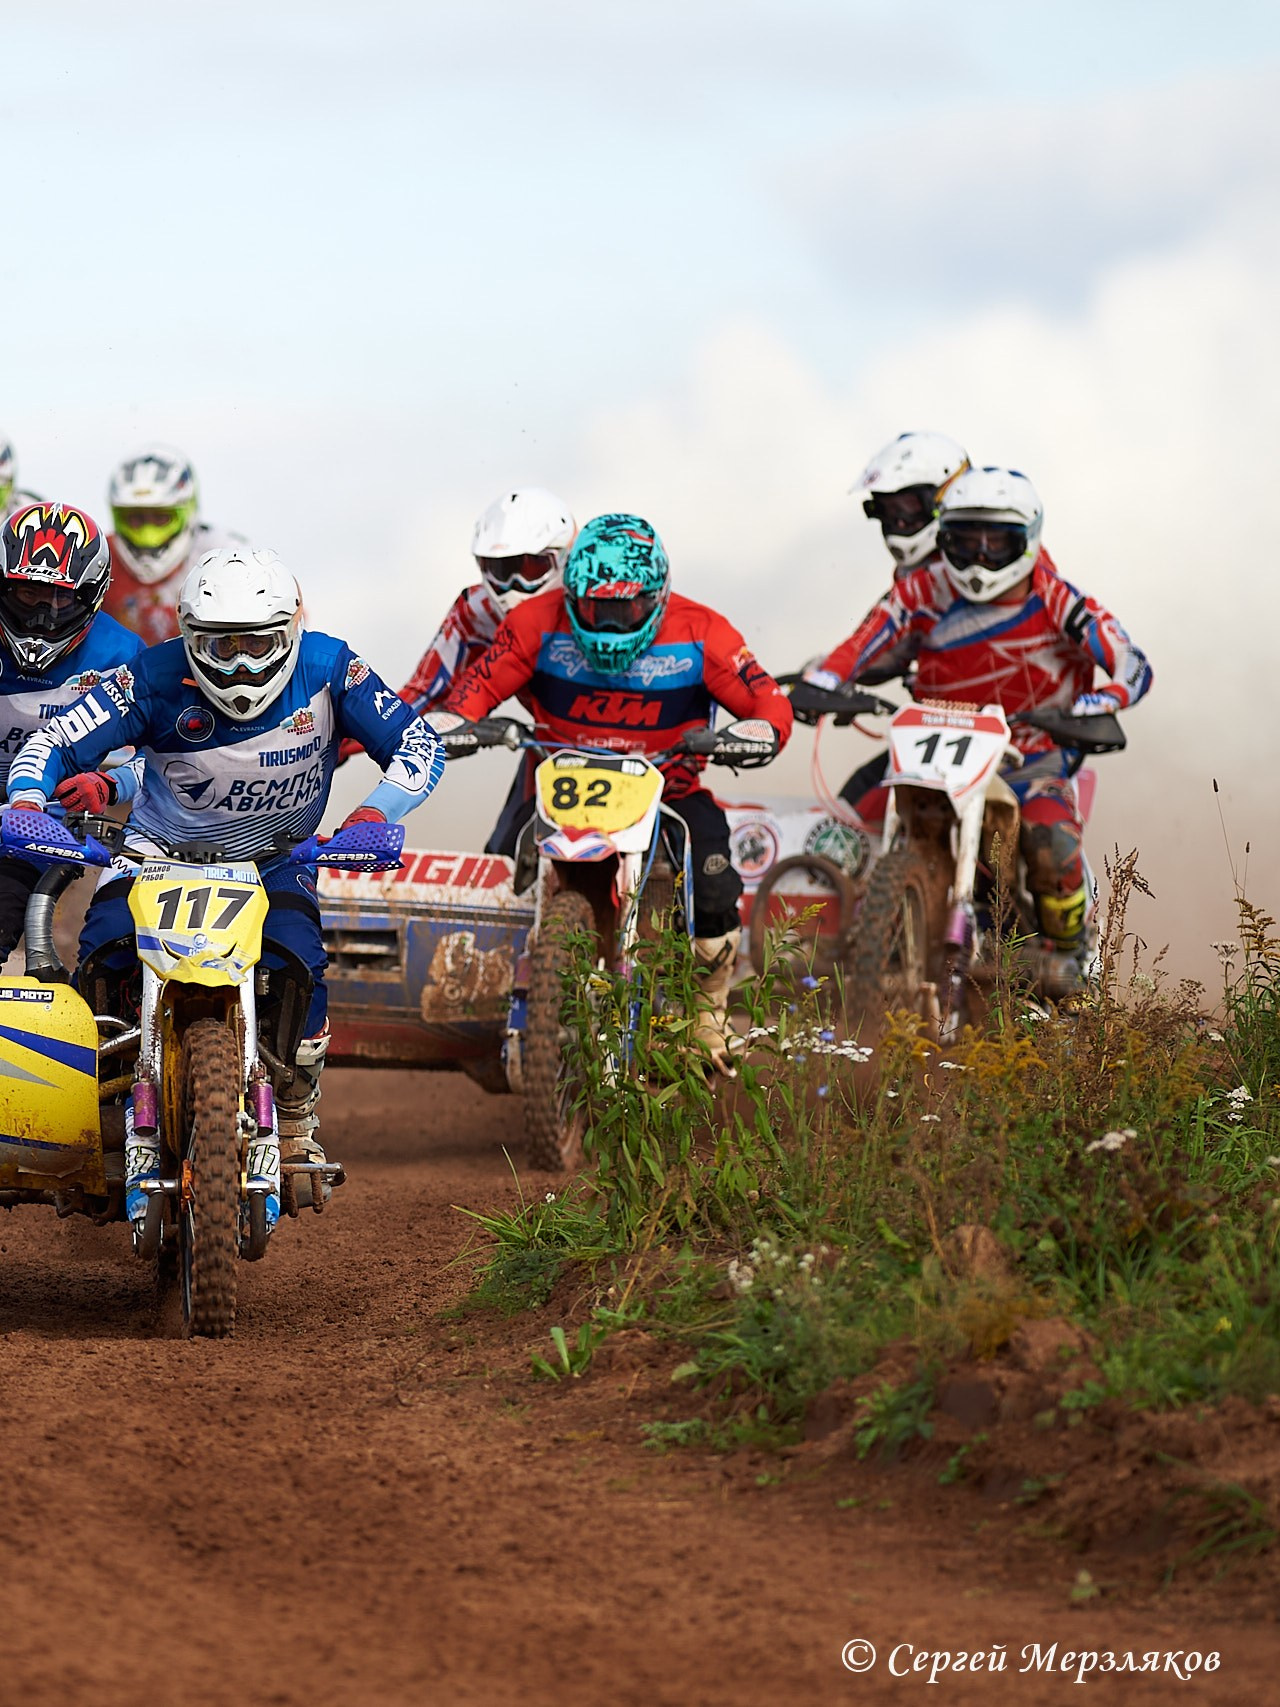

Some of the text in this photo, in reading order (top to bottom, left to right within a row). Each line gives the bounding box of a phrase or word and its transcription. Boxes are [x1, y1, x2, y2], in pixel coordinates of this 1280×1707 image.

[568, 691, 662, 726] KTM
[239, 725, 265, 733] EVRAZEN
[714, 743, 773, 753] ACERBIS
[915, 733, 973, 766] 11
[214, 775, 323, 812] АВИСМА
[228, 763, 318, 796] ВСМПО
[552, 777, 612, 809] 82
[25, 843, 85, 860] ACERBIS
[316, 853, 377, 861] ACERBIS
[202, 866, 258, 884] TIRUS_MOTO
[157, 886, 255, 930] 117
[248, 1144, 281, 1175] 17
